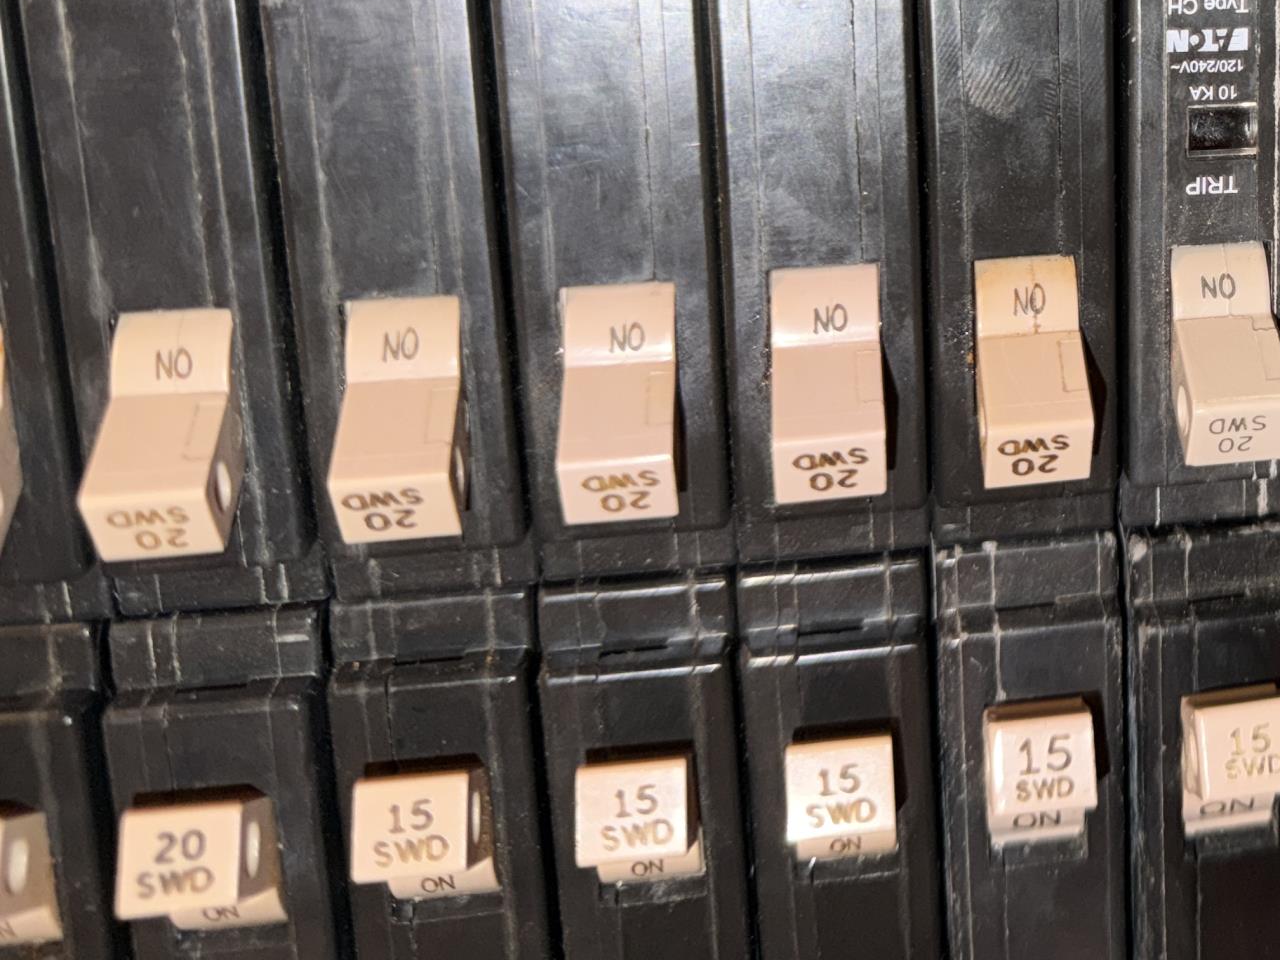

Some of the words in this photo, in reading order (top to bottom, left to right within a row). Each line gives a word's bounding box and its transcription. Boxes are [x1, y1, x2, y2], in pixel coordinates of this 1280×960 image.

[1166, 27, 1249, 53] EATON
[1170, 59, 1244, 74] 120/240V~
[1189, 86, 1214, 101] KA
[1218, 84, 1238, 100] 10
[1185, 175, 1239, 196] TRIP
[1200, 272, 1237, 301] ON
[1012, 283, 1047, 317] ON
[813, 302, 849, 335] ON
[381, 326, 420, 364] ON
[608, 321, 646, 354] ON
[155, 346, 194, 381] ON
[1208, 415, 1268, 436] SWD
[997, 434, 1071, 458] SWD
[1217, 436, 1254, 454] 20
[792, 447, 870, 470] SWD
[1011, 454, 1060, 478] 20
[581, 470, 661, 493] SWD
[809, 467, 859, 492] 20
[341, 488, 424, 512] SWD
[600, 490, 653, 513] 20
[106, 505, 191, 529] SWD
[364, 509, 420, 533] 20
[135, 527, 190, 552] 20
[1229, 721, 1272, 757] 15
[1017, 733, 1073, 777] 15
[817, 763, 862, 797] 15
[1014, 776, 1075, 803] SWD
[613, 783, 659, 819] 15
[805, 797, 878, 829] SWD
[1200, 796, 1255, 816] ON
[388, 798, 434, 834] 15
[1012, 810, 1062, 830] ON
[153, 829, 207, 865] 20
[599, 818, 675, 853] SWD
[829, 836, 862, 853] ON
[373, 834, 450, 868] SWD
[630, 858, 665, 878] ON
[136, 867, 215, 900] SWD
[420, 873, 457, 894] ON
[202, 906, 241, 922] ON
